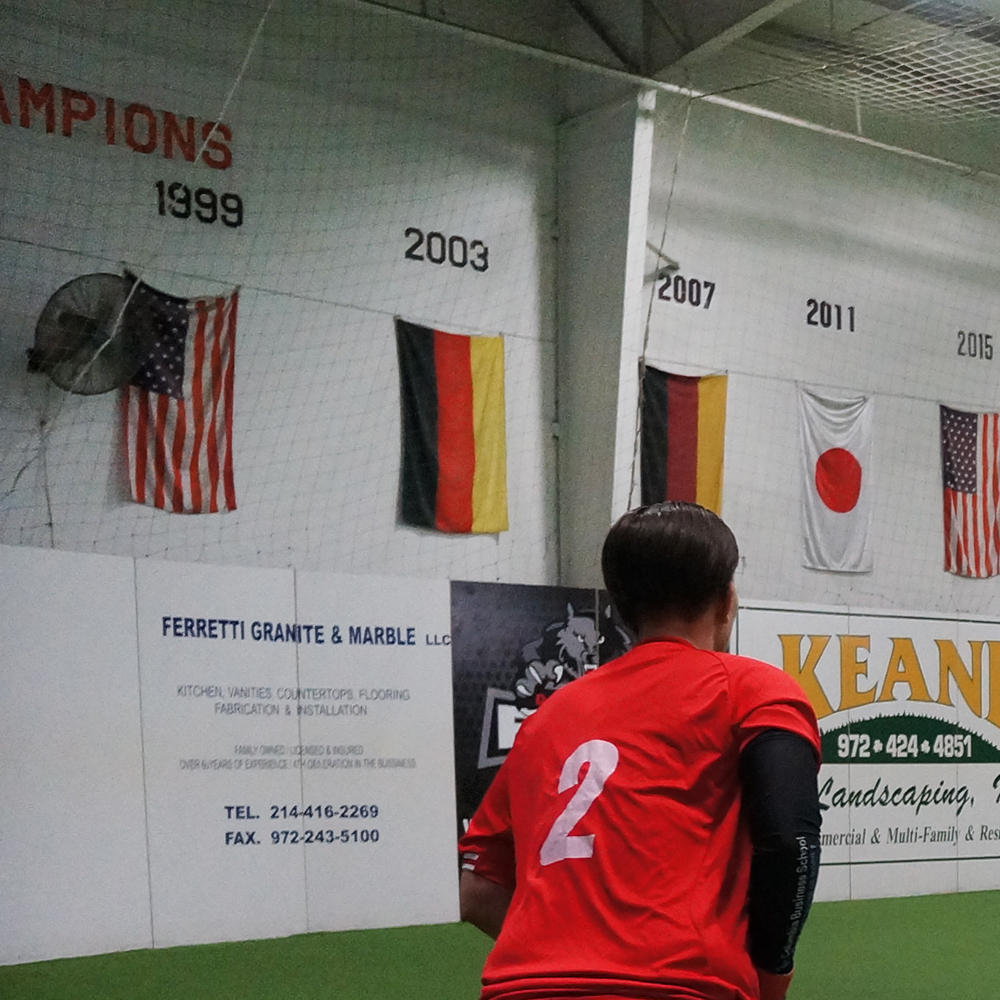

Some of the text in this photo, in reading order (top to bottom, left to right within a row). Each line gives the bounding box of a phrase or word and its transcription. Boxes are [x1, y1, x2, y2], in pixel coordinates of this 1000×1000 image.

[155, 180, 244, 228] 1999
[404, 228, 490, 272] 2003
[658, 274, 716, 310] 2007
[806, 299, 855, 332] 2011
[957, 330, 993, 360] 2015
[162, 616, 452, 646] FERRETTI GRANITE & MARBLE LLC
[214, 702, 367, 716] FABRICATION & INSTALLATION
[224, 804, 379, 819] TEL. 214-416-2269
[540, 739, 619, 866] 2
[225, 829, 380, 845] FAX. 972-243-5100
[819, 827, 866, 846] mercial
[870, 829, 881, 845] &
[886, 825, 959, 846] Multi-Family
[965, 826, 974, 841] &
[796, 836, 808, 873] School
